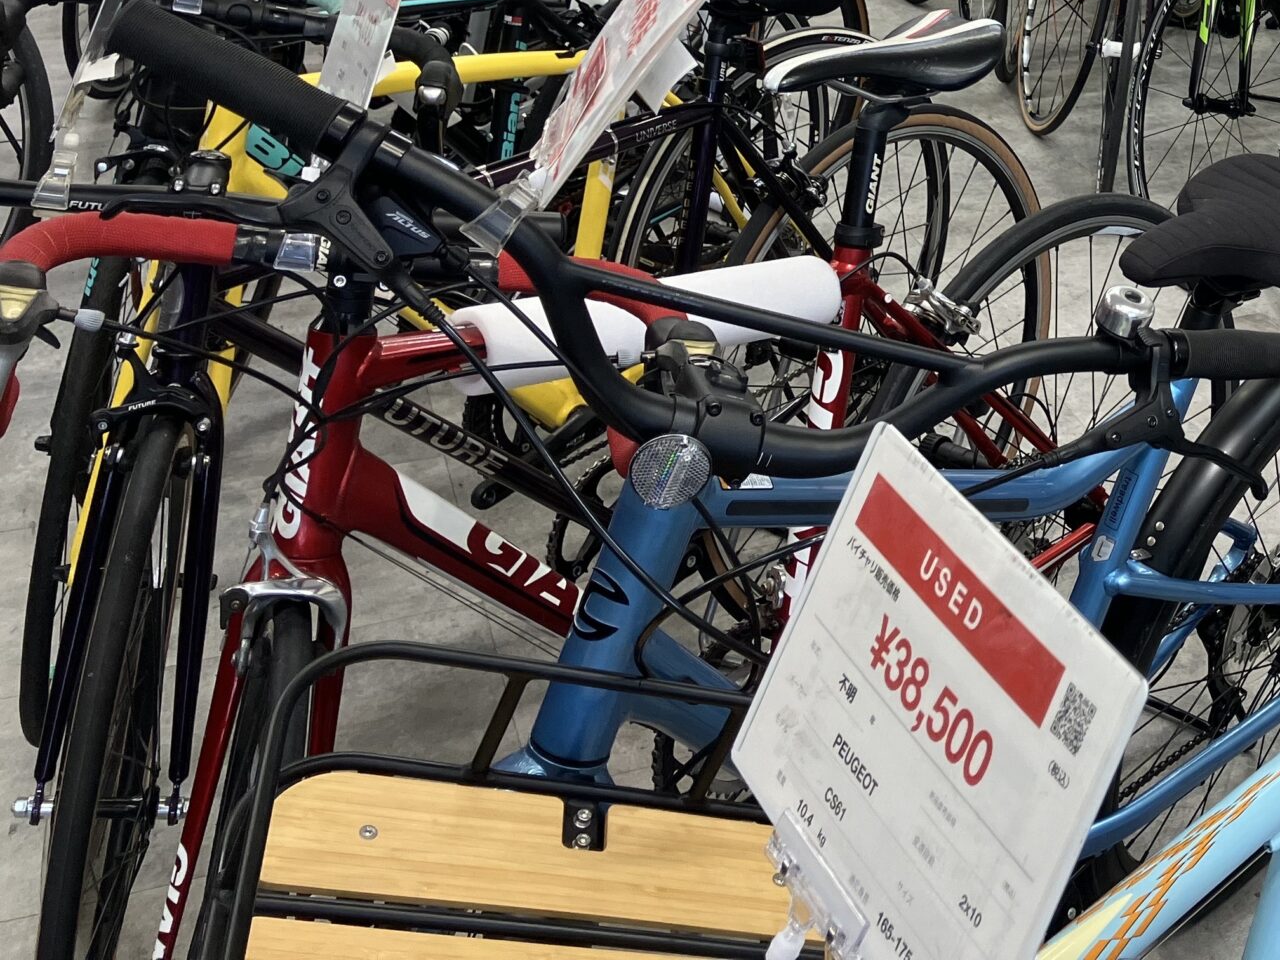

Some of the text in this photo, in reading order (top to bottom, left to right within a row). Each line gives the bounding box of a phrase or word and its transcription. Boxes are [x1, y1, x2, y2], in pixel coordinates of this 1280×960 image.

[635, 119, 678, 143] UNIVERSE
[865, 152, 884, 215] GIANT
[384, 213, 431, 239] ALTUS
[128, 400, 157, 412] FUTURE
[1109, 474, 1131, 525] treadwell
[846, 535, 901, 602] バイチャリ販売価格
[919, 548, 984, 631] USED
[838, 672, 859, 705] 不明
[869, 612, 993, 786] ¥38,500
[832, 732, 879, 797] PEUGEOT
[824, 786, 848, 822] CS61
[816, 828, 828, 849] kg
[957, 894, 984, 929] 2x10
